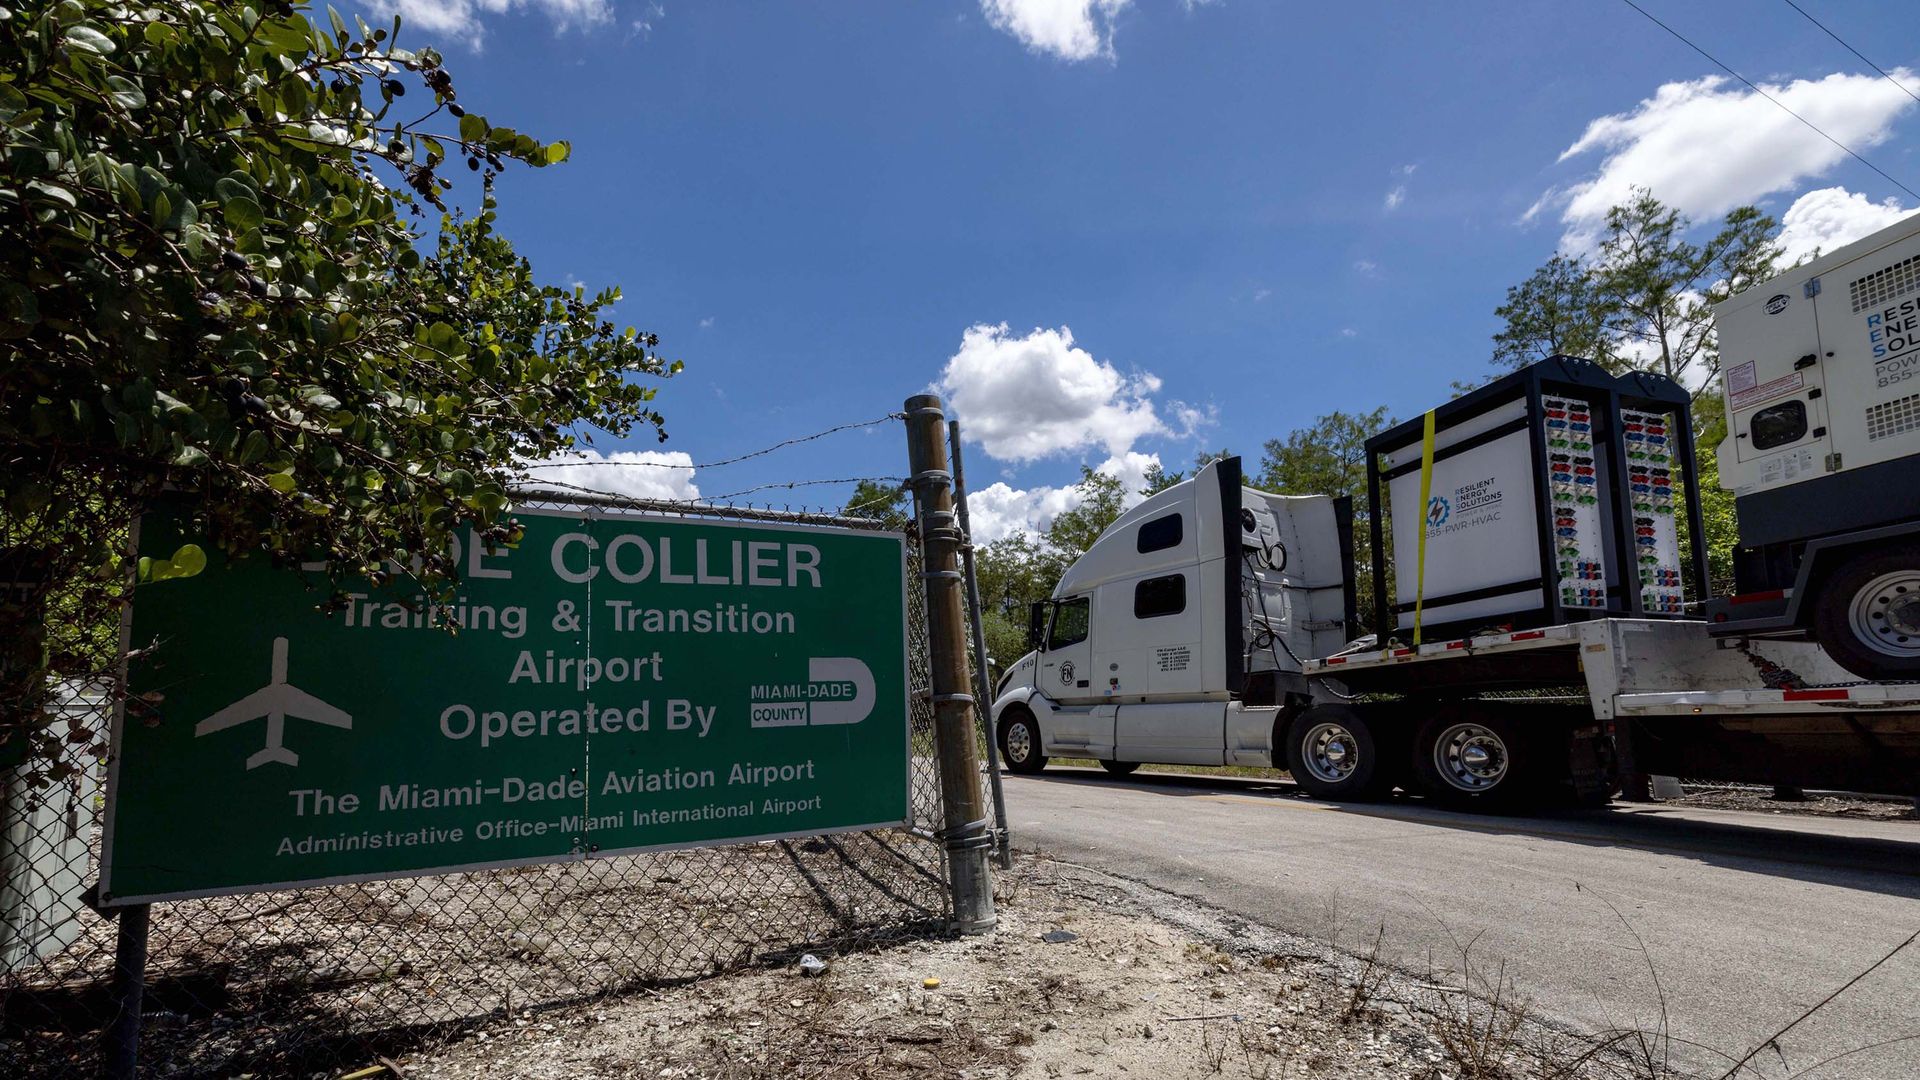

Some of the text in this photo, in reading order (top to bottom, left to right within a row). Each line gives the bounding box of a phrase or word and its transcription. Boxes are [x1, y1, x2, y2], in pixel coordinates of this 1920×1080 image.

[1455, 477, 1495, 495] RESILIENT
[1455, 488, 1488, 503] ENERGY
[1456, 491, 1502, 510] SOLUTIONS
[551, 533, 822, 588] COLLIER
[551, 600, 582, 633] &
[605, 600, 795, 634] Transition
[508, 650, 663, 691] Airport
[1022, 659, 1034, 671] F10
[751, 684, 852, 699] MIAMI-DADE
[440, 699, 717, 748] Operated By
[753, 707, 805, 722] COUNTY
[289, 760, 815, 817] The Miami-Dade Aviation Airport
[276, 795, 821, 856] Administrative Office-Miami International Airport
